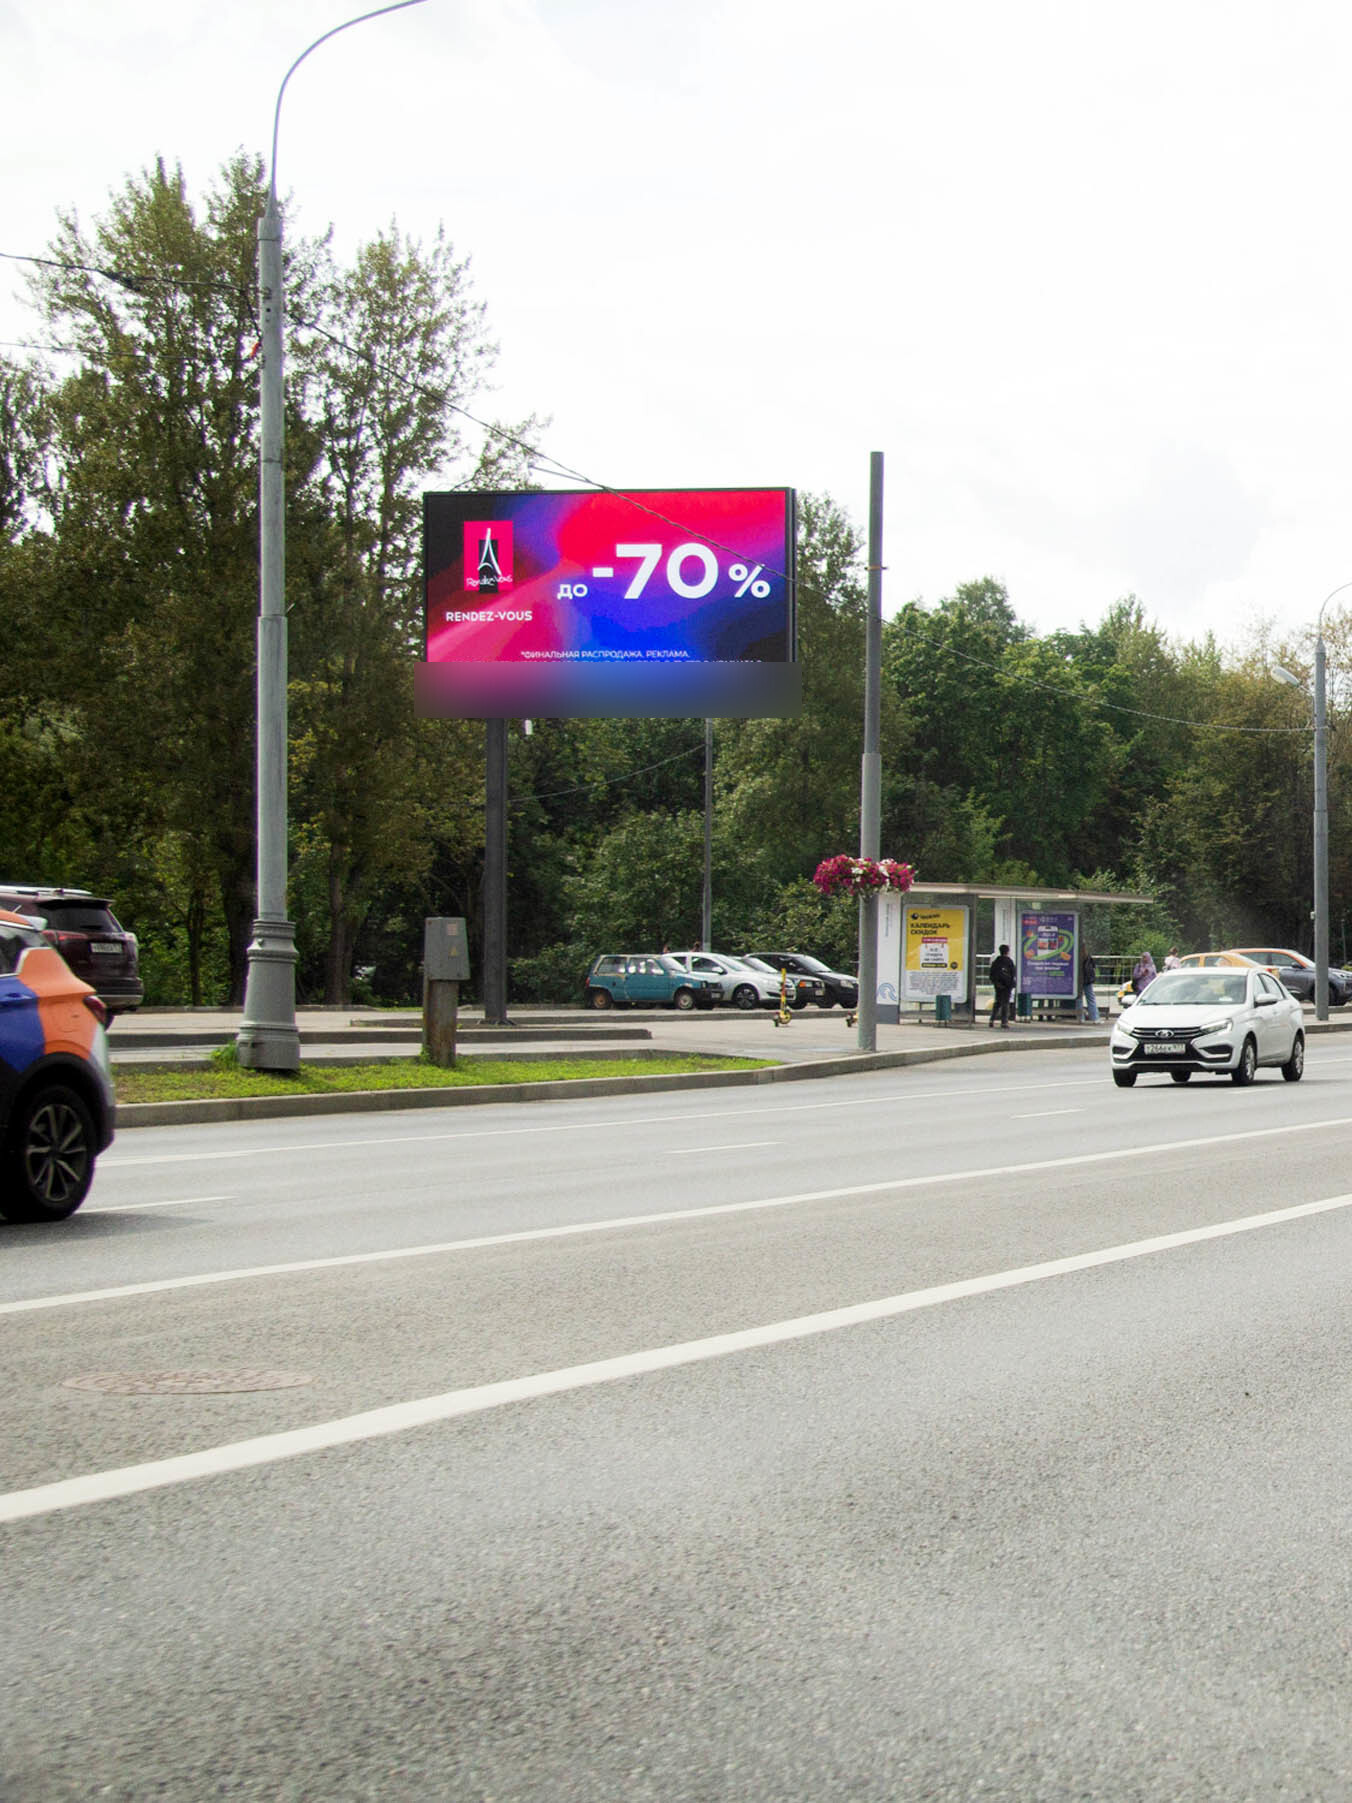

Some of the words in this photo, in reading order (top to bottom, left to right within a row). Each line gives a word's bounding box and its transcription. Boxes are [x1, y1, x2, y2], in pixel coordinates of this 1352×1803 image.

[592, 542, 719, 599] -70
[728, 563, 772, 599] %
[446, 611, 533, 622] RENDEZ-VOUS
